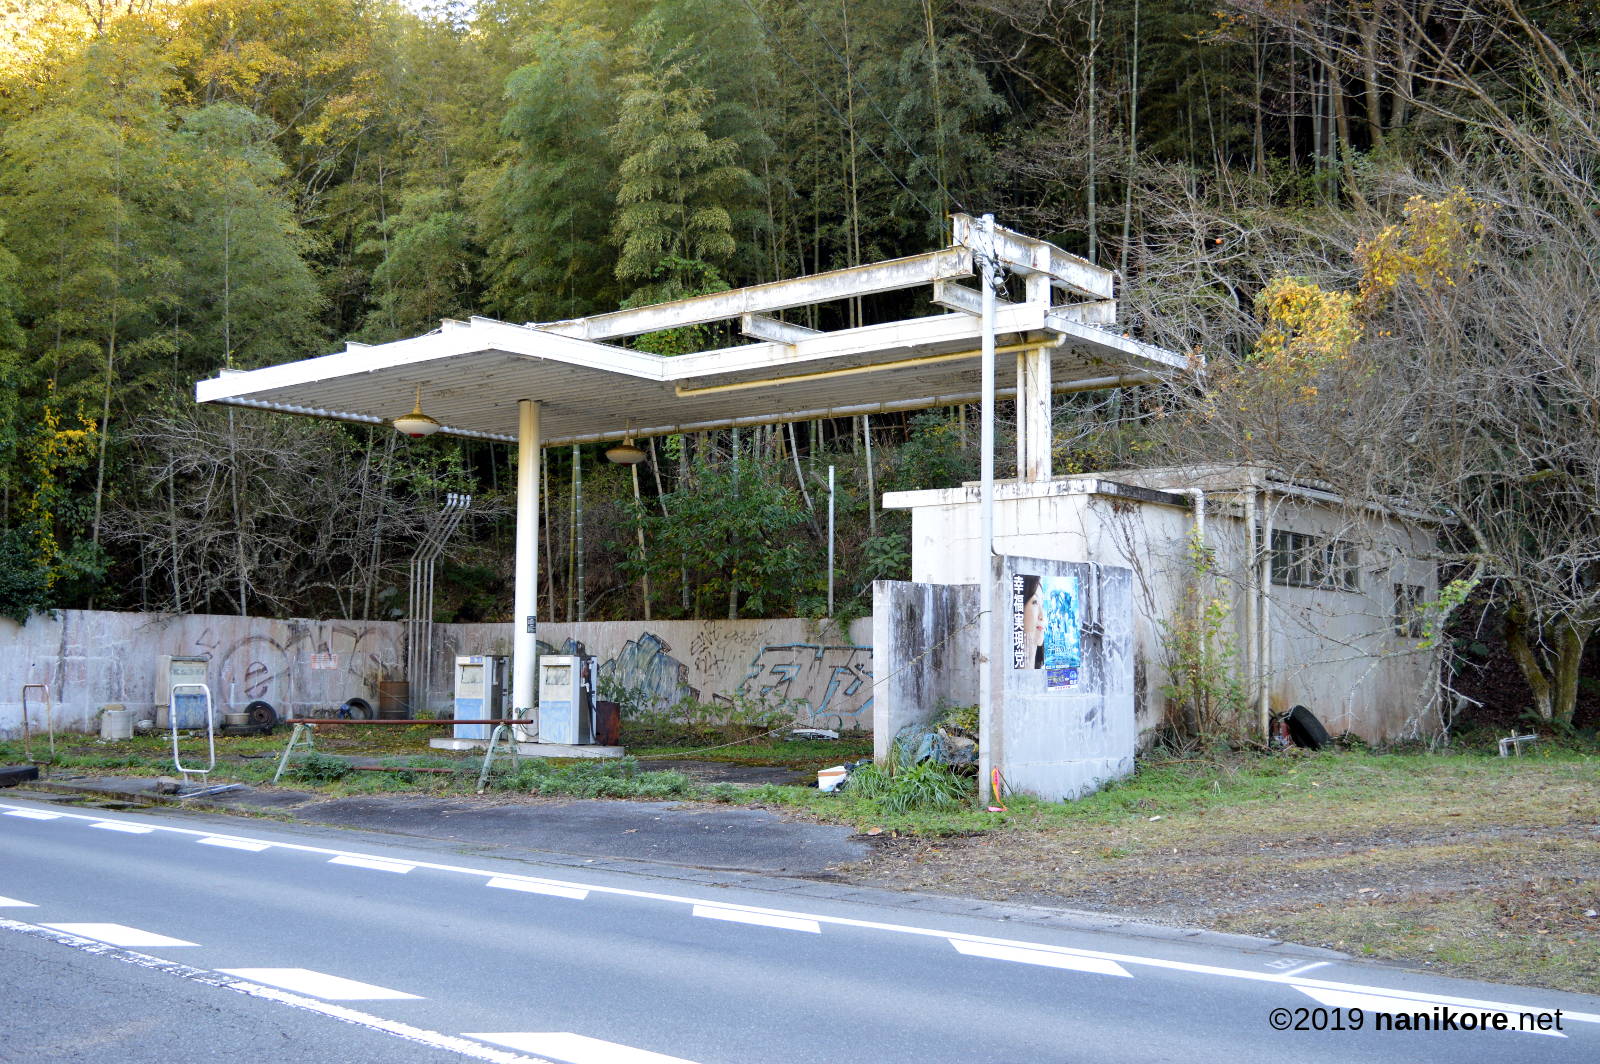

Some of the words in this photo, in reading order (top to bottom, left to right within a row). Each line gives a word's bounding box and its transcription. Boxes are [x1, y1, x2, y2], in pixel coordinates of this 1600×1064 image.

[1013, 575, 1025, 668] 幸福実現党
